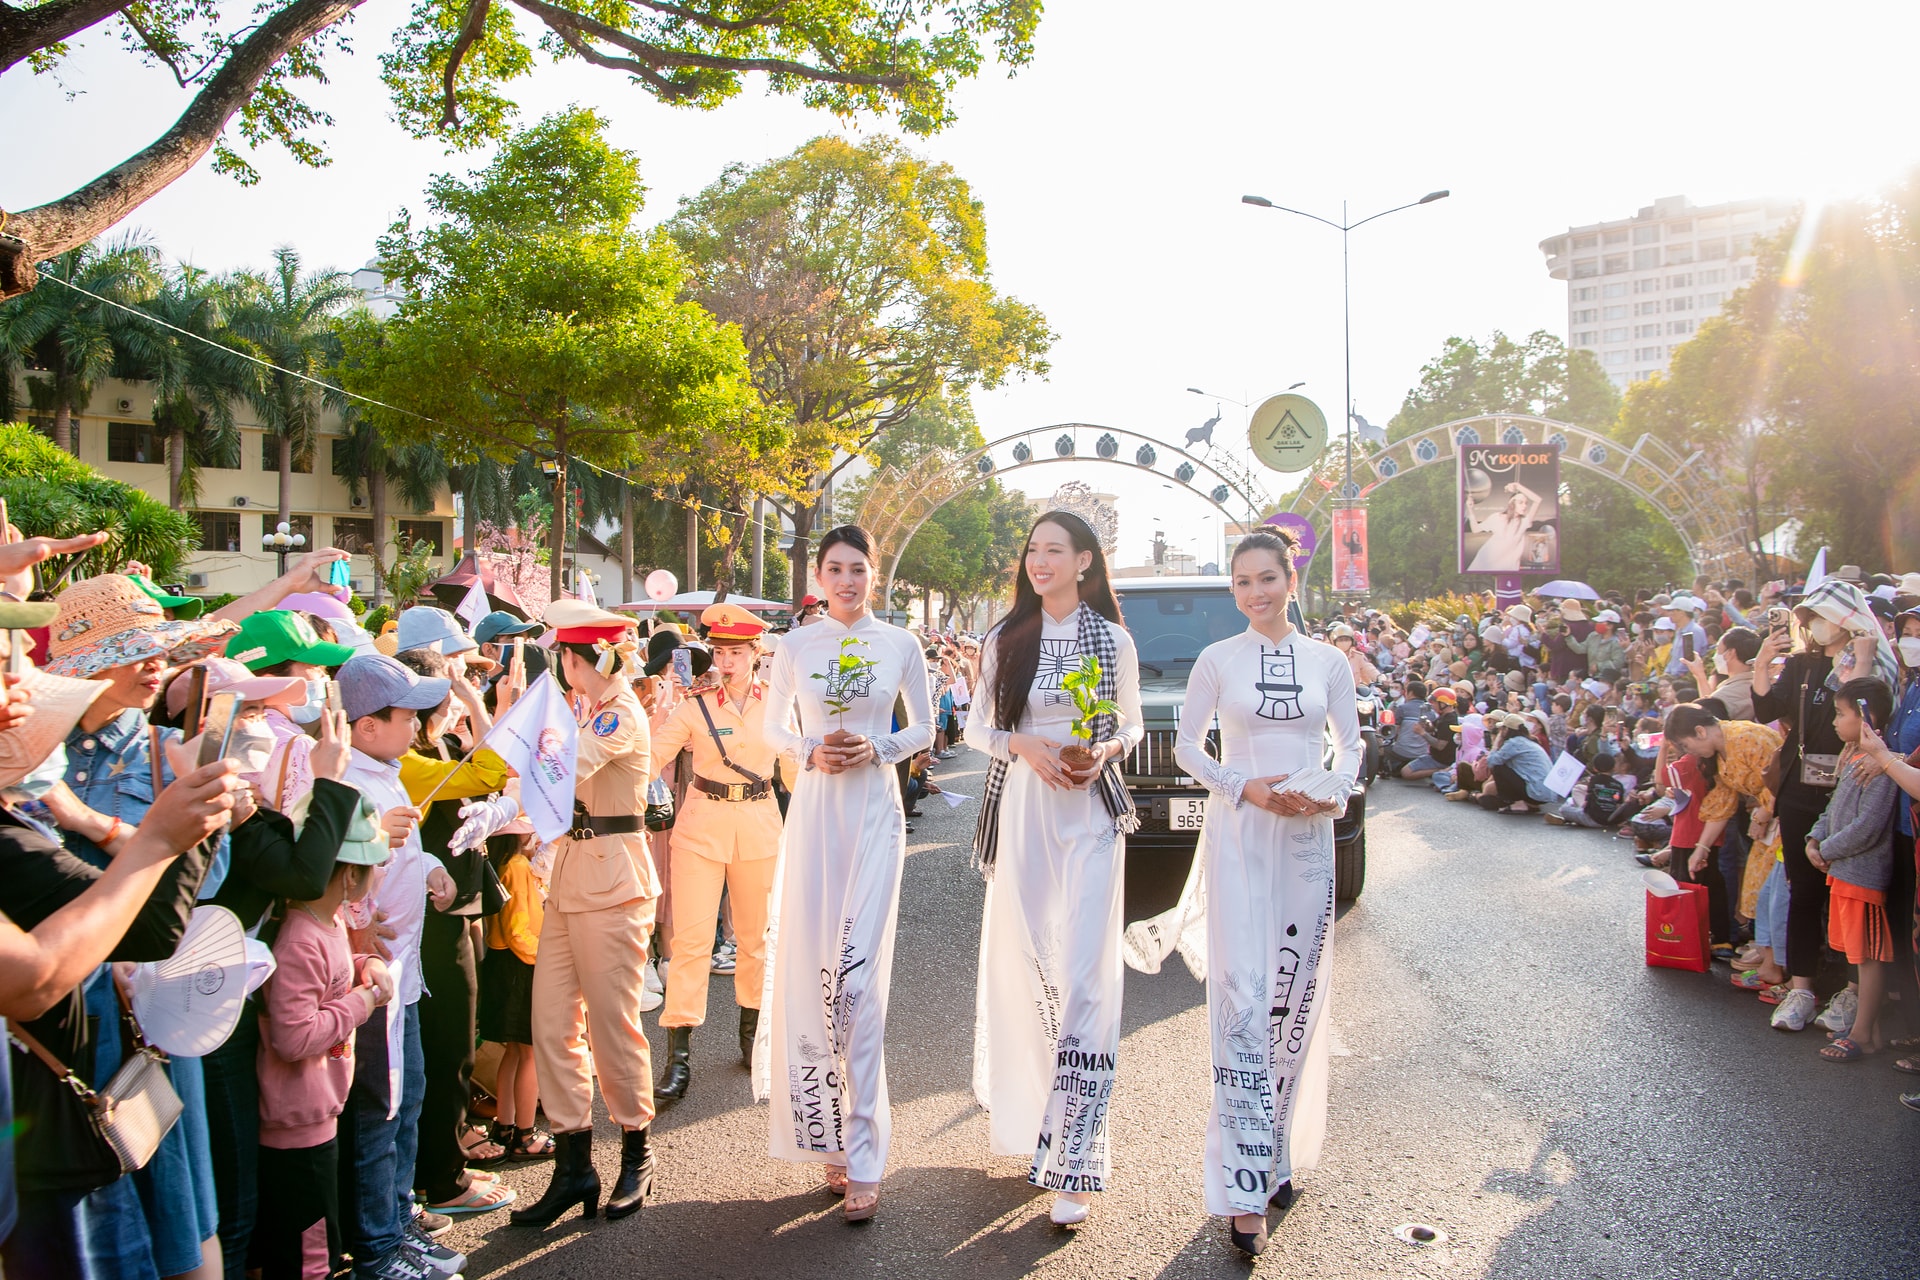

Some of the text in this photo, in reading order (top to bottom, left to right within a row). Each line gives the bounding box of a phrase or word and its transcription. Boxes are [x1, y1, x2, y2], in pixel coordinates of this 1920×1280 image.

[1188, 800, 1204, 813] 51
[1286, 978, 1318, 1054] COFFEE
[1058, 1033, 1080, 1049] coffee
[1057, 1049, 1115, 1071] ROMAN
[1053, 1070, 1097, 1098] coffee
[1057, 1095, 1078, 1167] COFFEE
[1069, 1102, 1090, 1155] ROMAN
